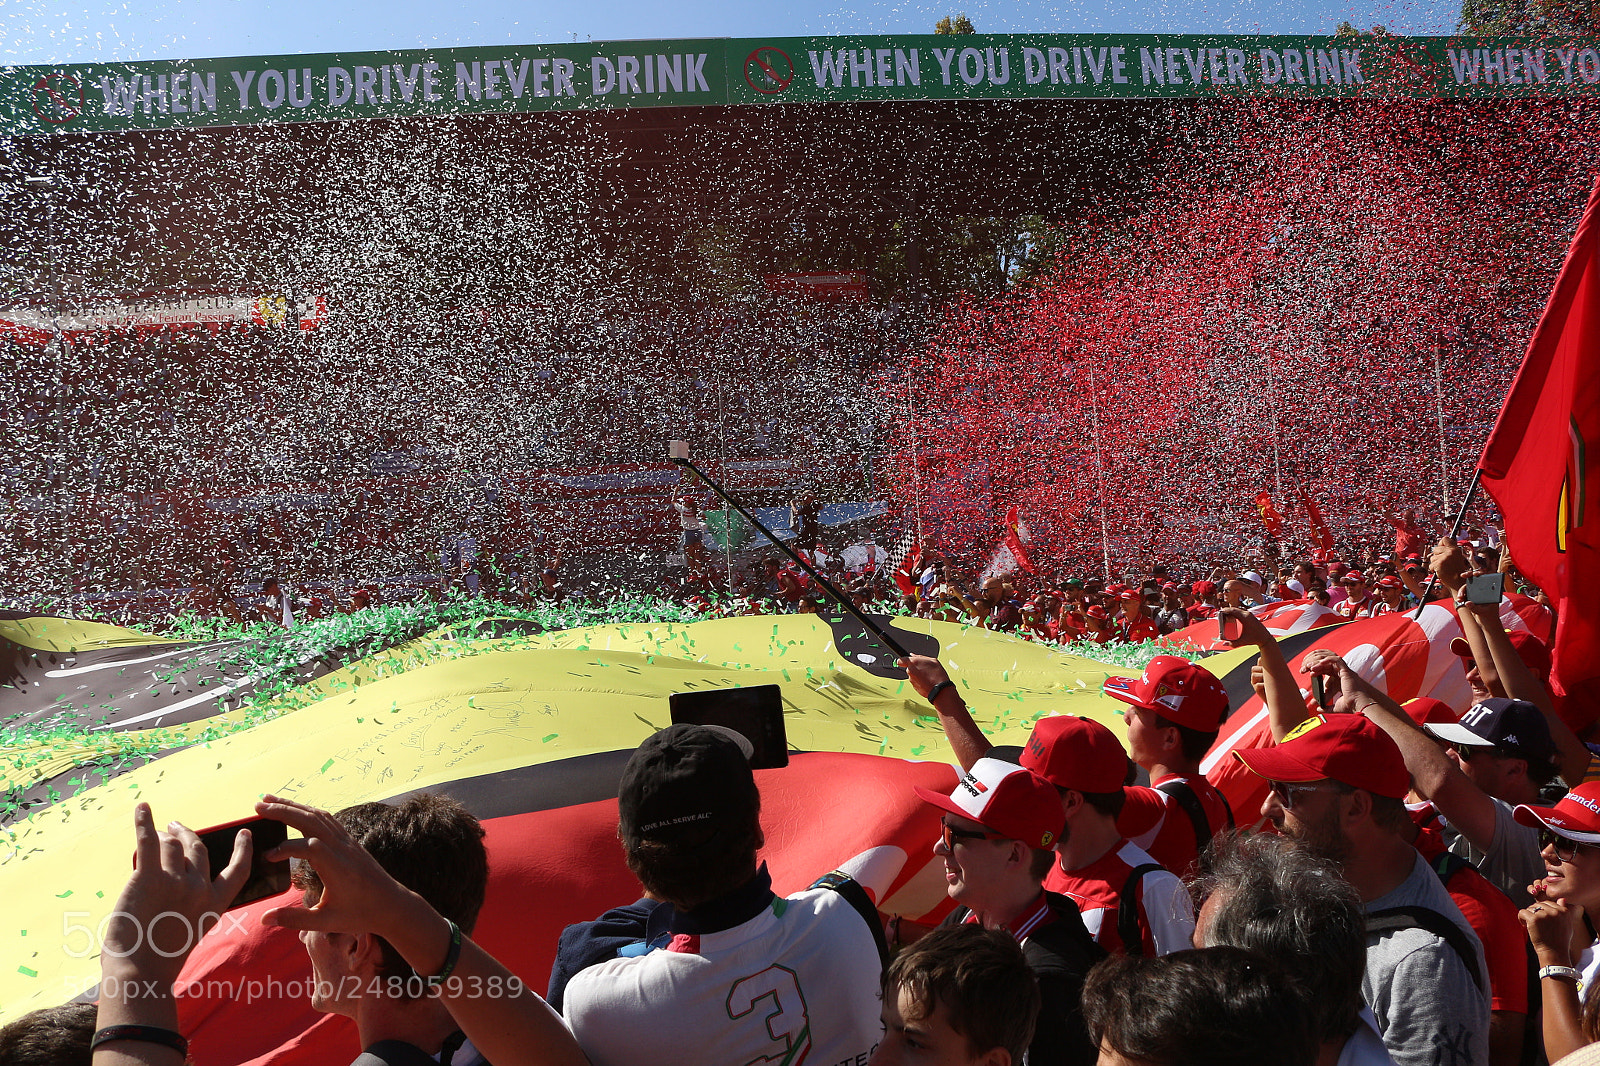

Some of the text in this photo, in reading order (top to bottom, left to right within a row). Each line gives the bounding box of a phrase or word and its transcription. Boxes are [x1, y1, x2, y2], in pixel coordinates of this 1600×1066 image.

[101, 54, 710, 117] WHEN YOU DRIVE NEVER DRINK
[809, 47, 1364, 87] WHEN YOU DRIVE NEVER DRINK
[1449, 48, 1545, 85] WHEN
[641, 822, 658, 832] LOVE
[659, 819, 672, 827] ALL
[673, 814, 696, 824] SERVE
